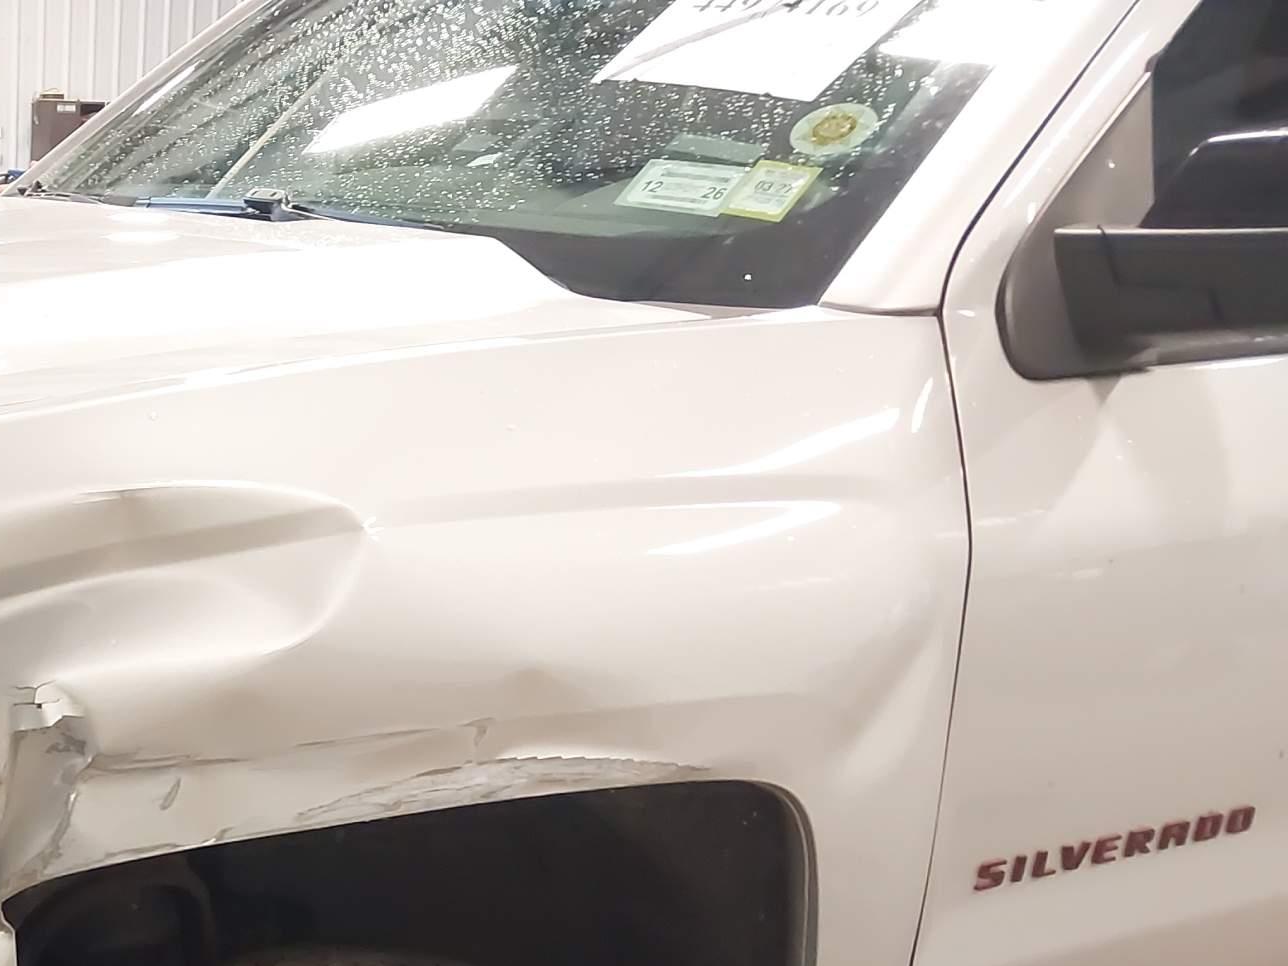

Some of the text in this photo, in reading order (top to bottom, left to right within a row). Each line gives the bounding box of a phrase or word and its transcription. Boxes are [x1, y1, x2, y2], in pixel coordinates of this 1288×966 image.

[640, 181, 664, 194] 12
[700, 186, 728, 200] 26
[973, 806, 1256, 891] SILVERADO
